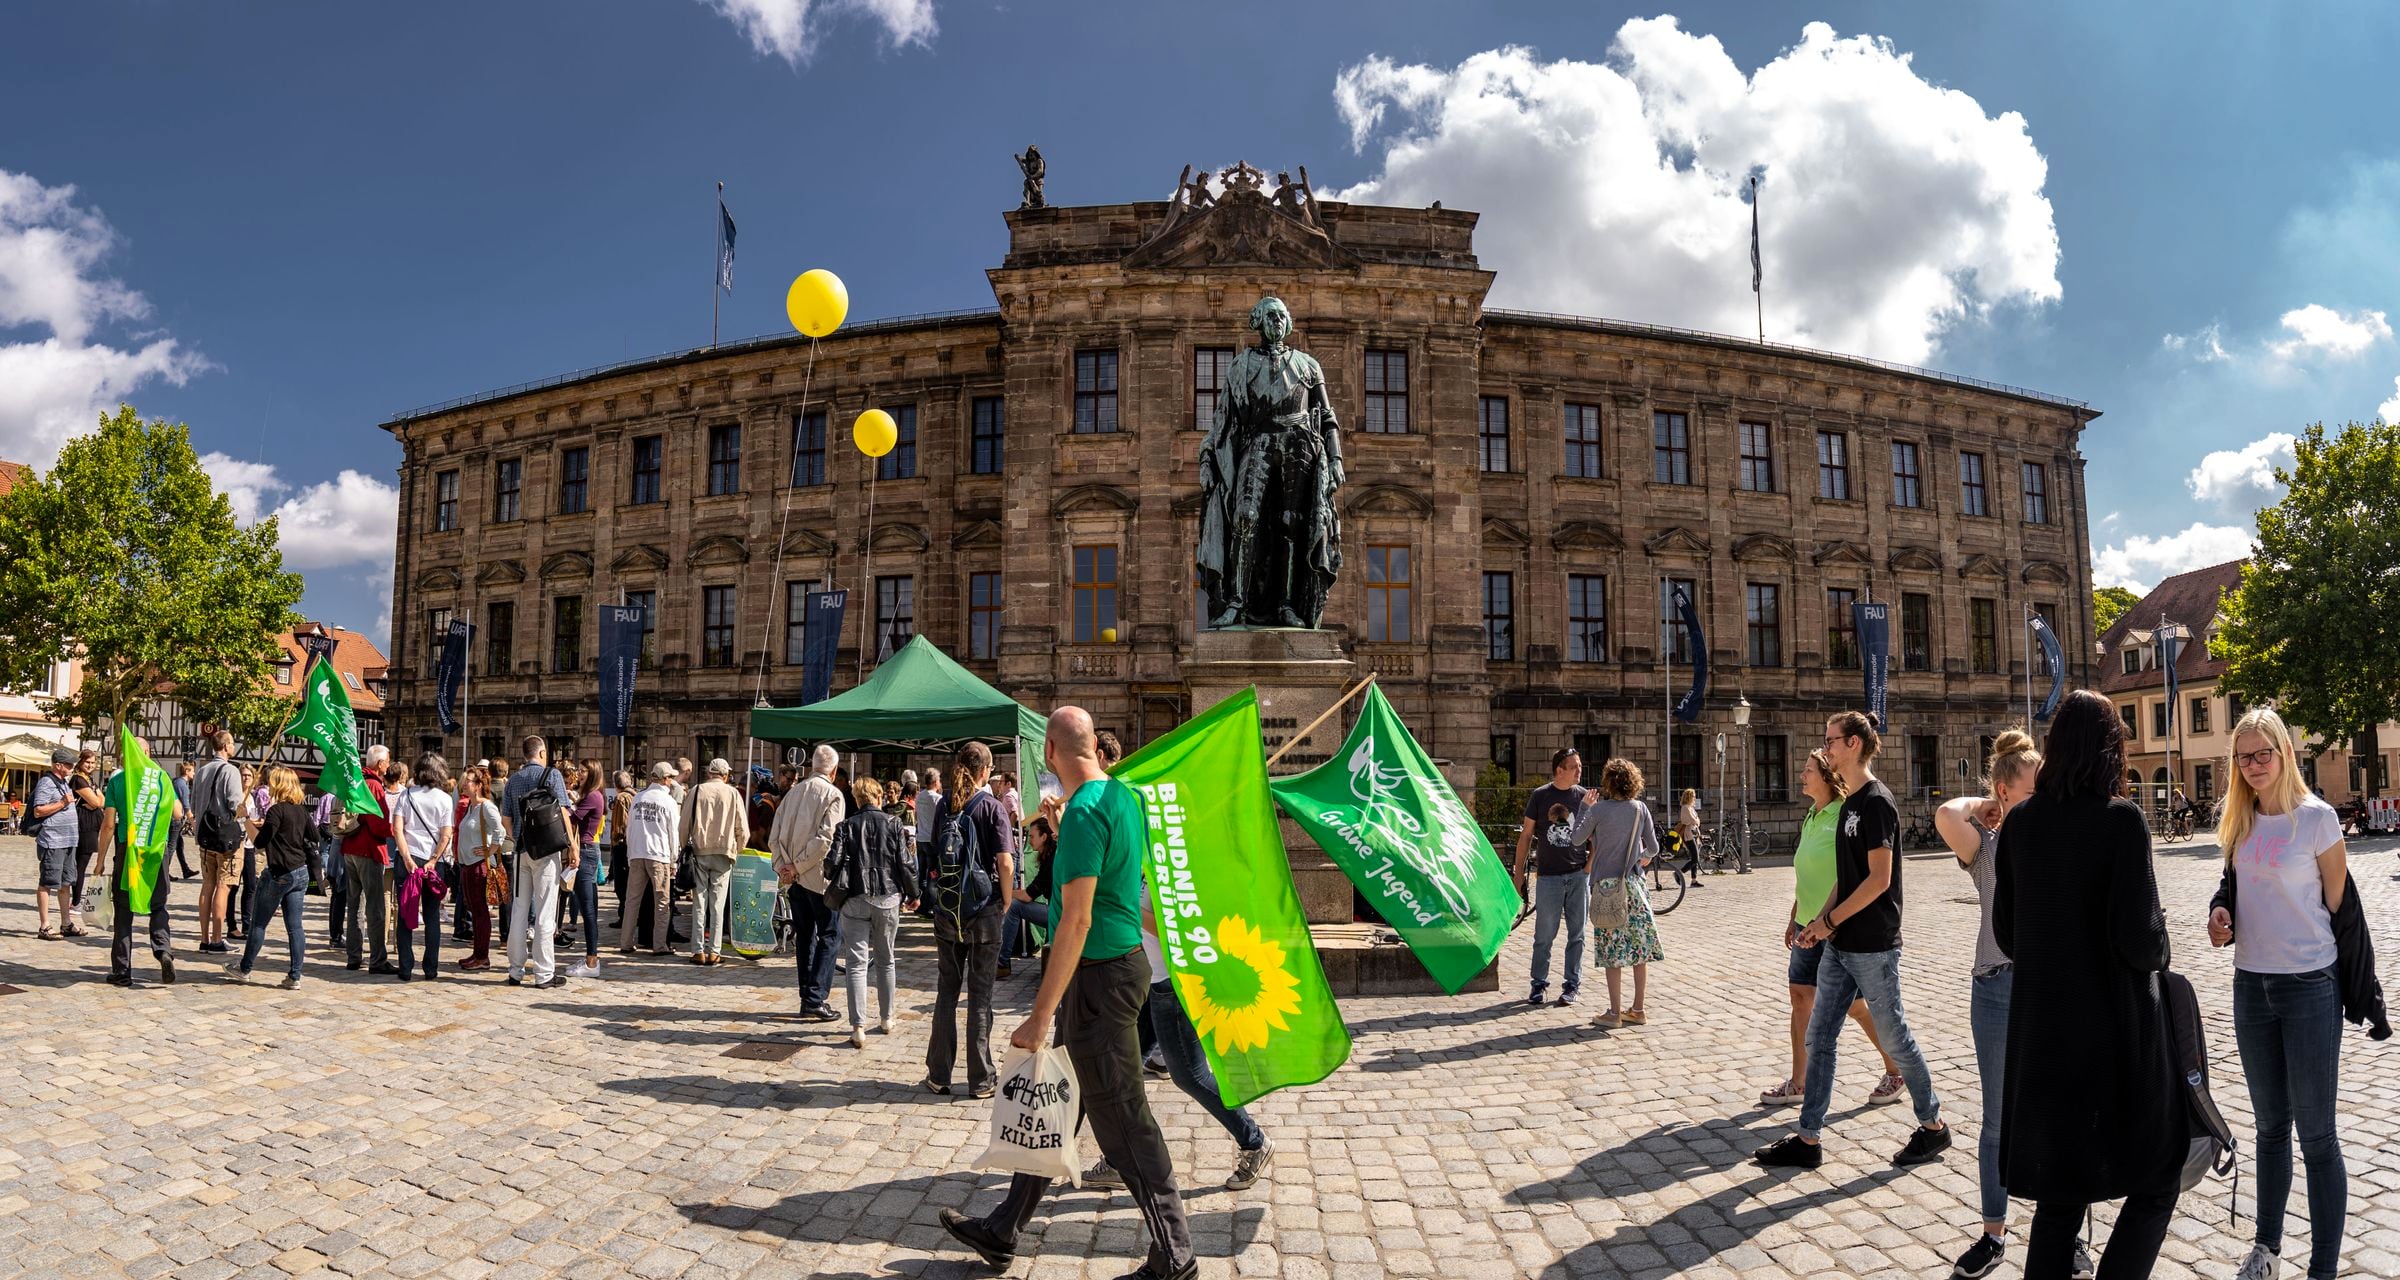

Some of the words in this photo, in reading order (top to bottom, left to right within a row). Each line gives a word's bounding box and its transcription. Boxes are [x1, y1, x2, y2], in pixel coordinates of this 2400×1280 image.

[821, 594, 843, 609] FAU
[614, 608, 640, 622] FAU
[1865, 606, 1885, 620] FAU
[313, 722, 341, 755] Grüne
[302, 794, 320, 806] Klim
[1141, 784, 1162, 830] DIE
[1153, 842, 1188, 968] GRÜNEN
[1158, 783, 1202, 918] BÜNDNIS
[1185, 926, 1218, 964] 90
[1320, 811, 1373, 859] Grüne
[1365, 857, 1442, 927] Jugend
[1017, 1113, 1033, 1131] IS
[1035, 1117, 1046, 1132] A
[1000, 1125, 1062, 1149] KILLER
